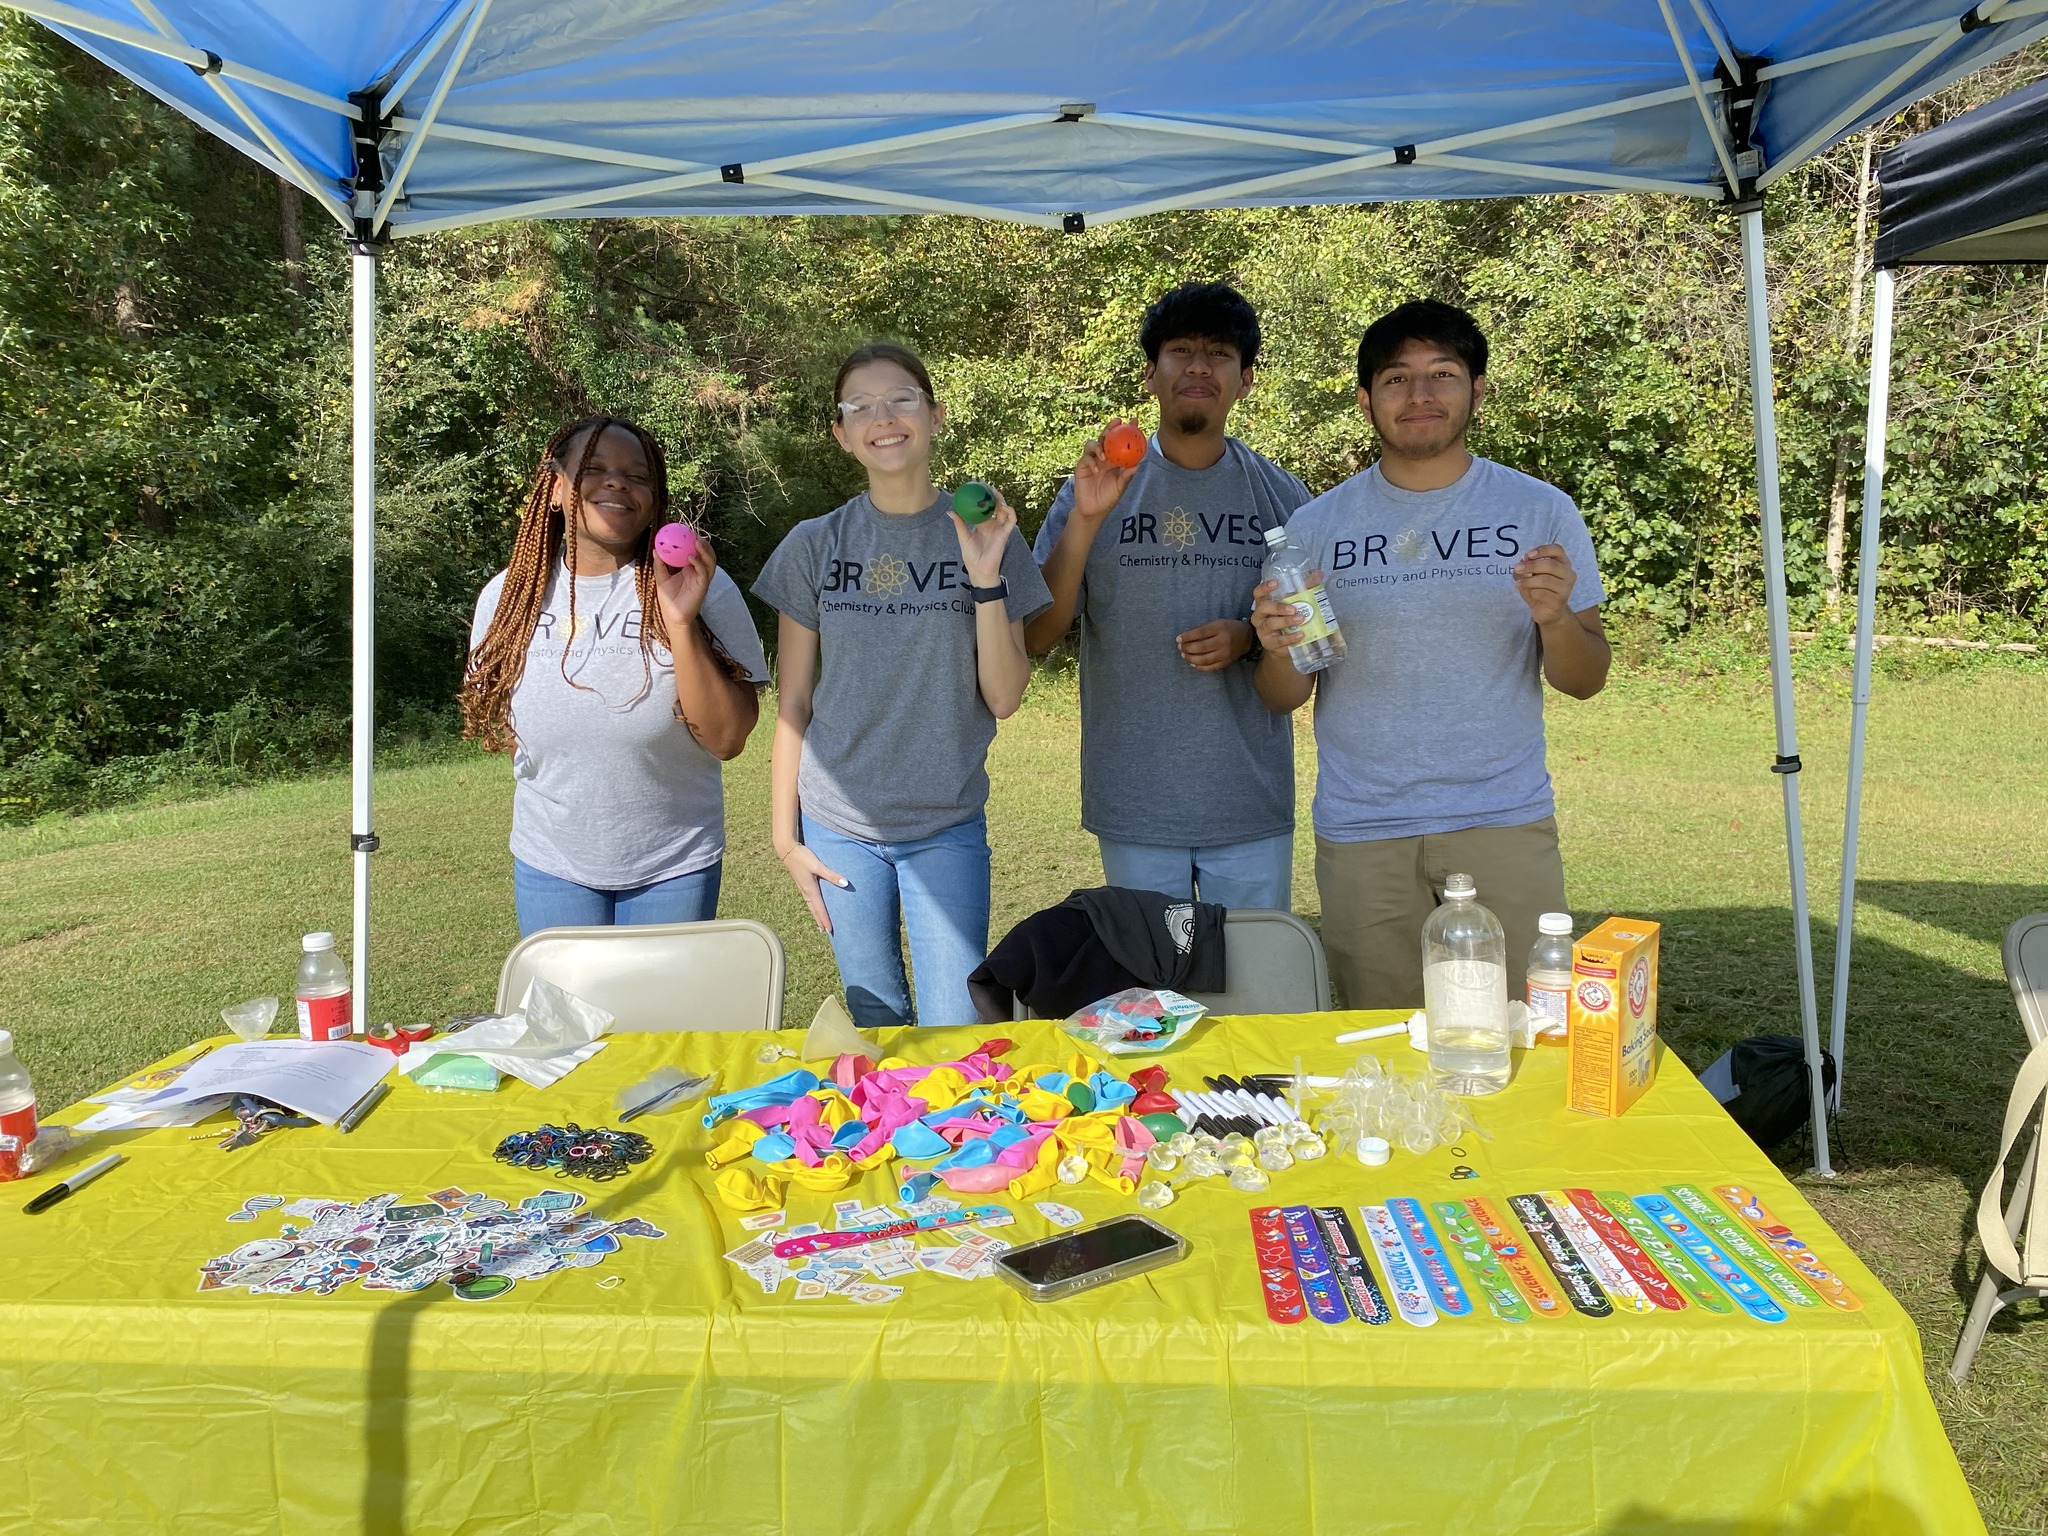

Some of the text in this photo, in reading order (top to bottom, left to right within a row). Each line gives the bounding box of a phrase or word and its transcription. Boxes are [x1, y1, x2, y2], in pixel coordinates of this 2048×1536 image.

[1120, 512, 1264, 546] BRVES
[1333, 524, 1519, 570] BRVES
[1120, 555, 1178, 568] Chemistry
[1181, 554, 1190, 565] &
[1194, 554, 1239, 568] Physics
[1336, 574, 1398, 588] Chemistry
[1403, 570, 1427, 582] and
[1431, 565, 1482, 580] Physics
[823, 600, 976, 616] Chemistry & Physics Club
[1622, 1037, 1642, 1057] Baking
[1643, 1022, 1655, 1041] Soda
[1465, 1198, 1493, 1226] SCIENCE
[1290, 1221, 1318, 1269] SCIENTIST
[1516, 1197, 1599, 1306] SCIENCE SCIENCE SCIENCE
[1581, 1207, 1614, 1224] DNA
[1605, 1237, 1641, 1256] DNA
[1631, 1269, 1669, 1291] DNA
[1620, 1217, 1698, 1282] SCIENCE
[1672, 1187, 1812, 1305] SCIENCE SCIENCE SCIENCE
[1385, 1250, 1418, 1291] SCIENCE
[1517, 1265, 1548, 1298] SCIENCE
